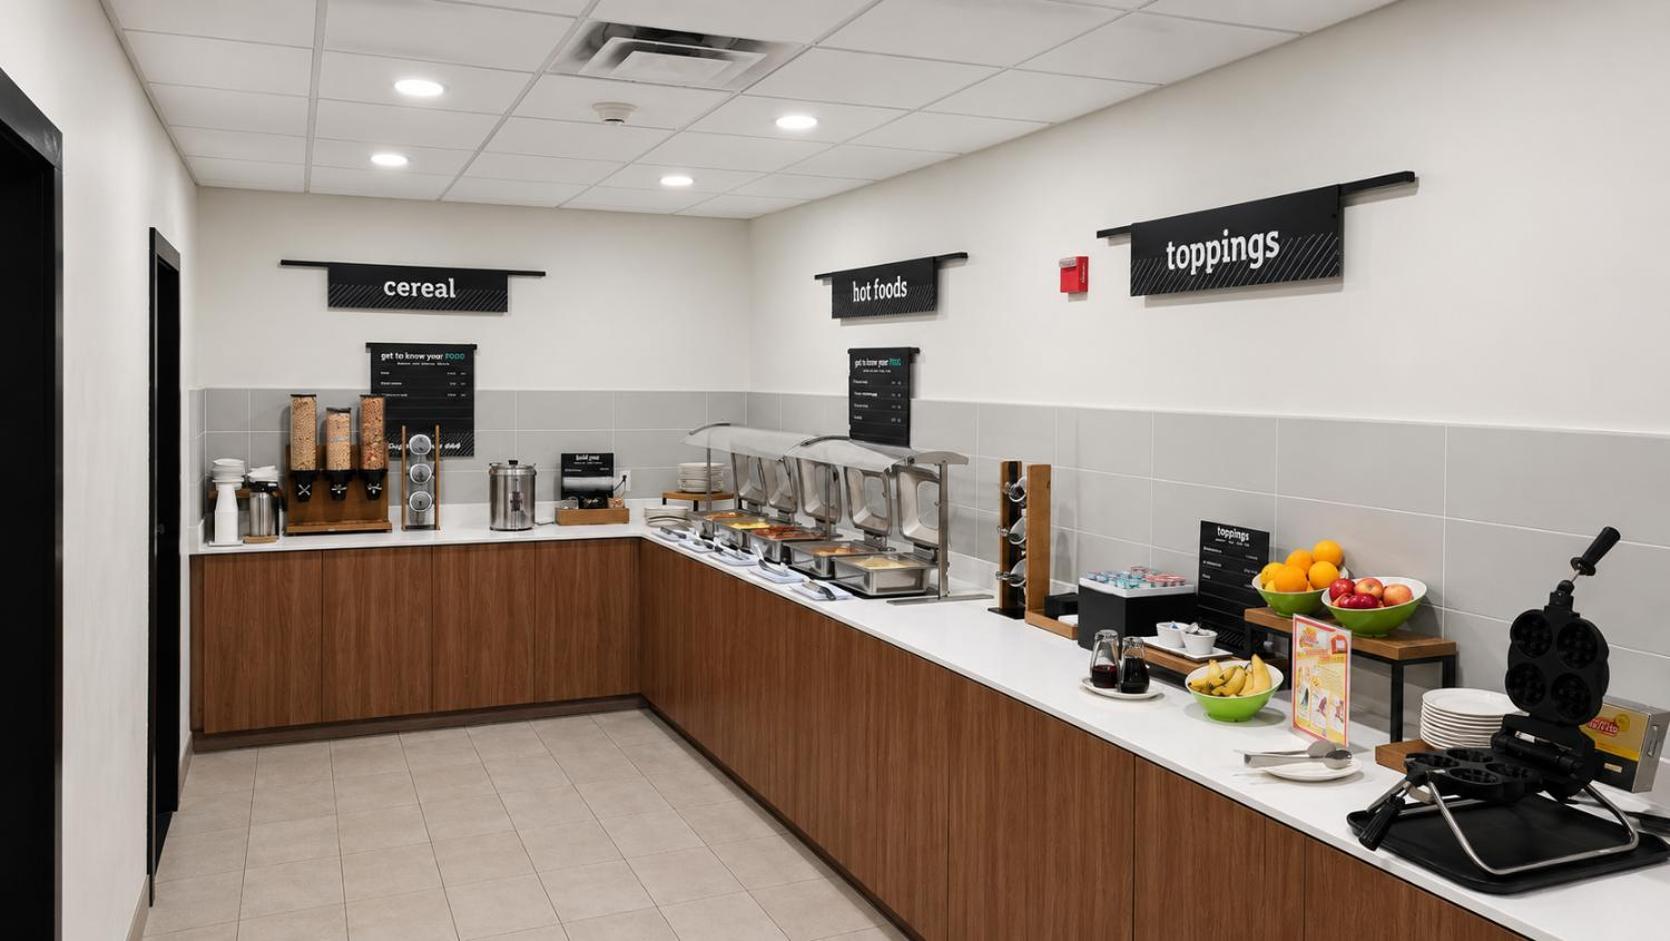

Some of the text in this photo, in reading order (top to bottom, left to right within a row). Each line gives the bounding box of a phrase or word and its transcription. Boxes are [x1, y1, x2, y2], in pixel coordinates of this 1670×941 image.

[1166, 229, 1280, 275] toppings
[384, 278, 456, 298] cereal
[853, 276, 908, 302] hot foods
[381, 353, 393, 361] get
[405, 352, 425, 360] know
[426, 353, 443, 361] your
[1217, 526, 1249, 542] toppings
